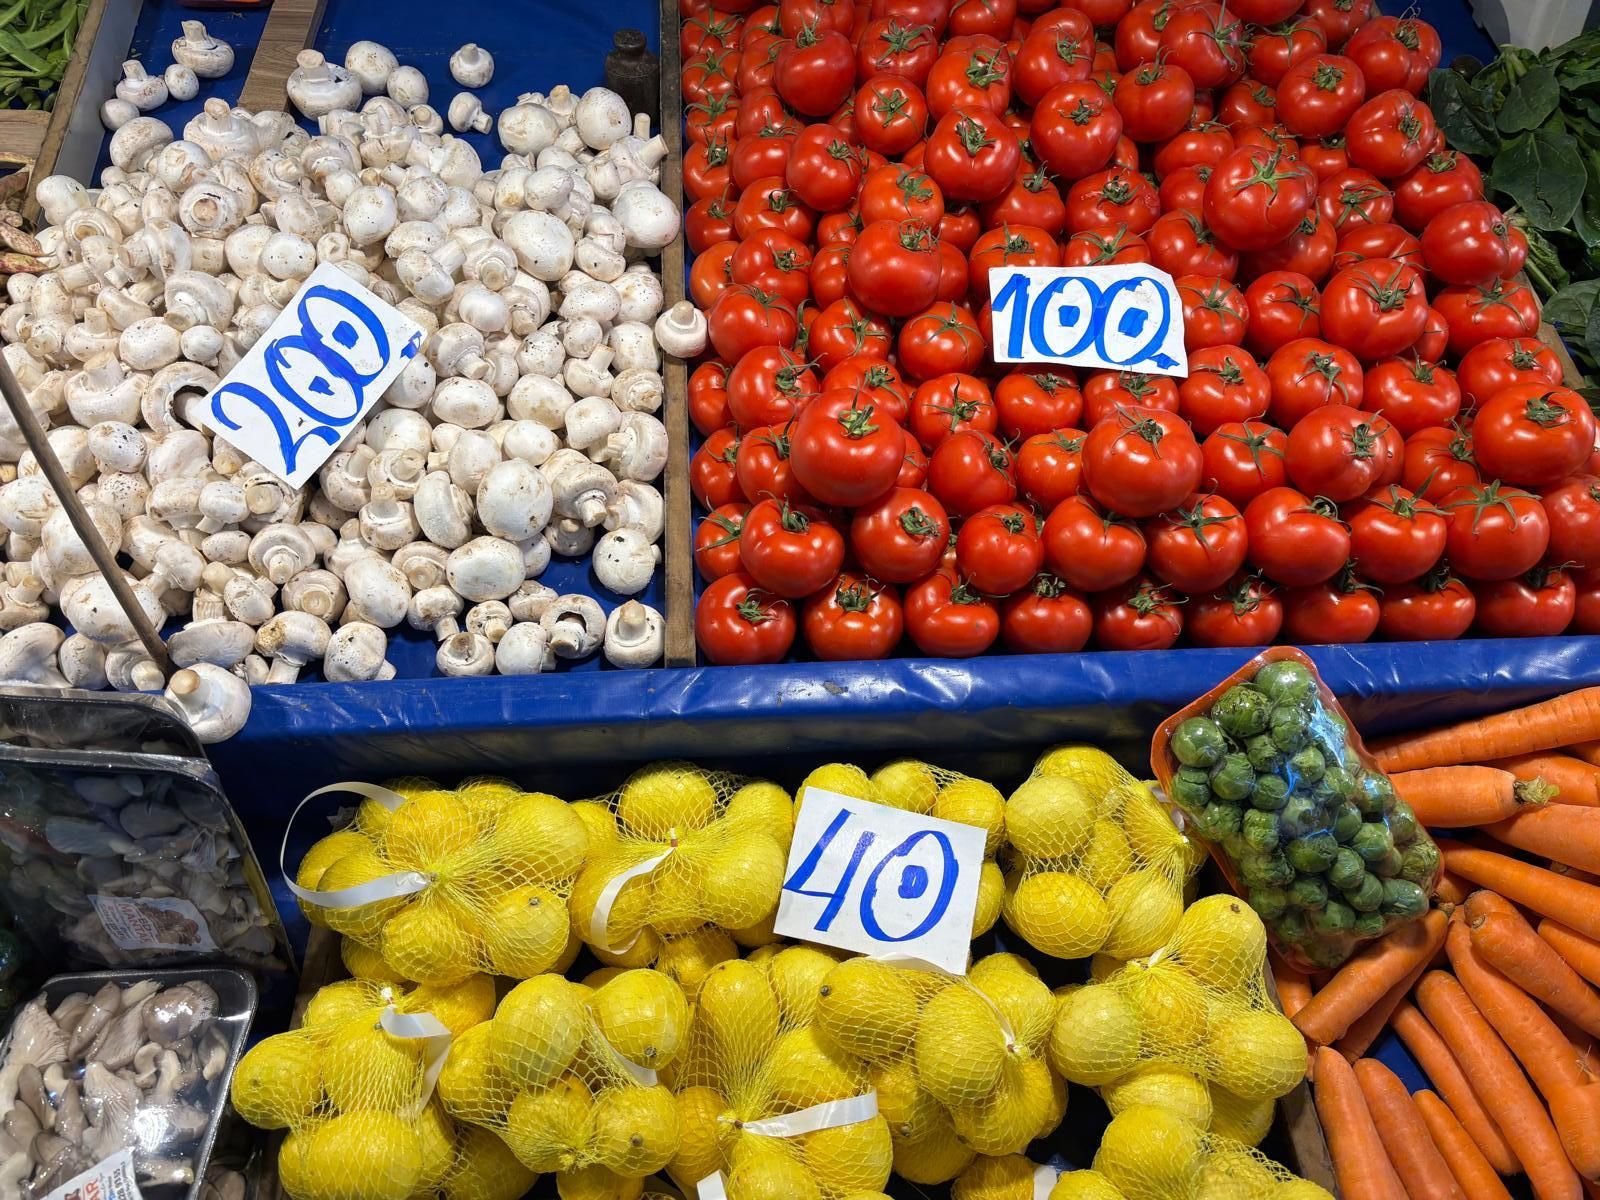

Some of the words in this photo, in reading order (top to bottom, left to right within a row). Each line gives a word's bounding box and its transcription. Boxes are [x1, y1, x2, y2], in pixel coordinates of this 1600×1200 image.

[211, 284, 391, 475] 200
[991, 273, 1172, 364] 100
[783, 808, 960, 942] 40
